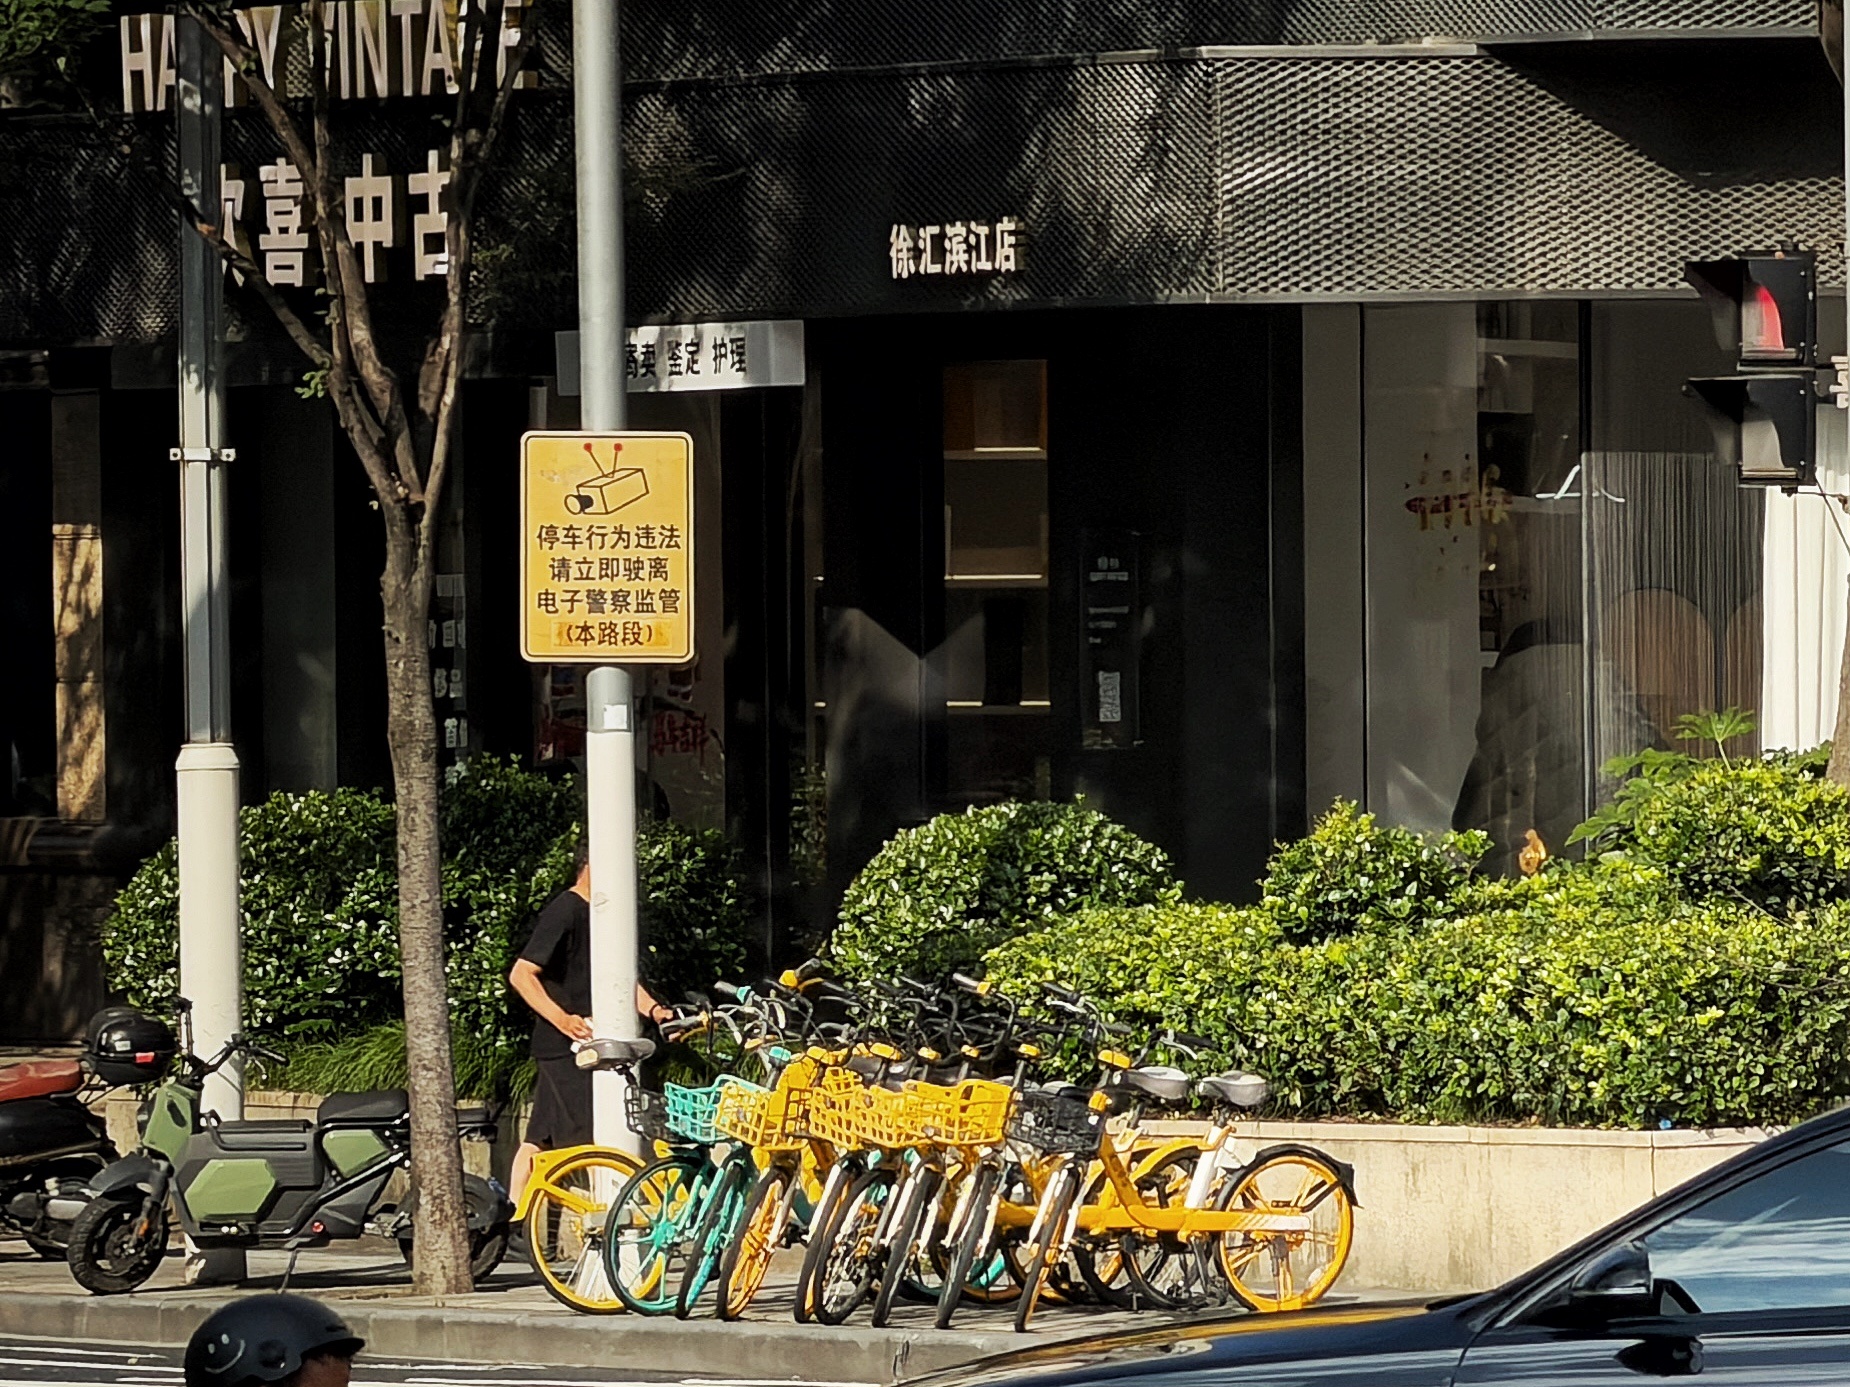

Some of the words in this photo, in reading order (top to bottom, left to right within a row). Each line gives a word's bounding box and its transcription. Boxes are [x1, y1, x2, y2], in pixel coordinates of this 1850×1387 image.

[889, 216, 1016, 279] 徐汇滨江店
[667, 338, 700, 377] 鉴定
[712, 336, 747, 374] 护理
[537, 524, 681, 550] 停车行为违法
[550, 557, 670, 583] 请立即驶离
[537, 589, 681, 615] 电子警察监管
